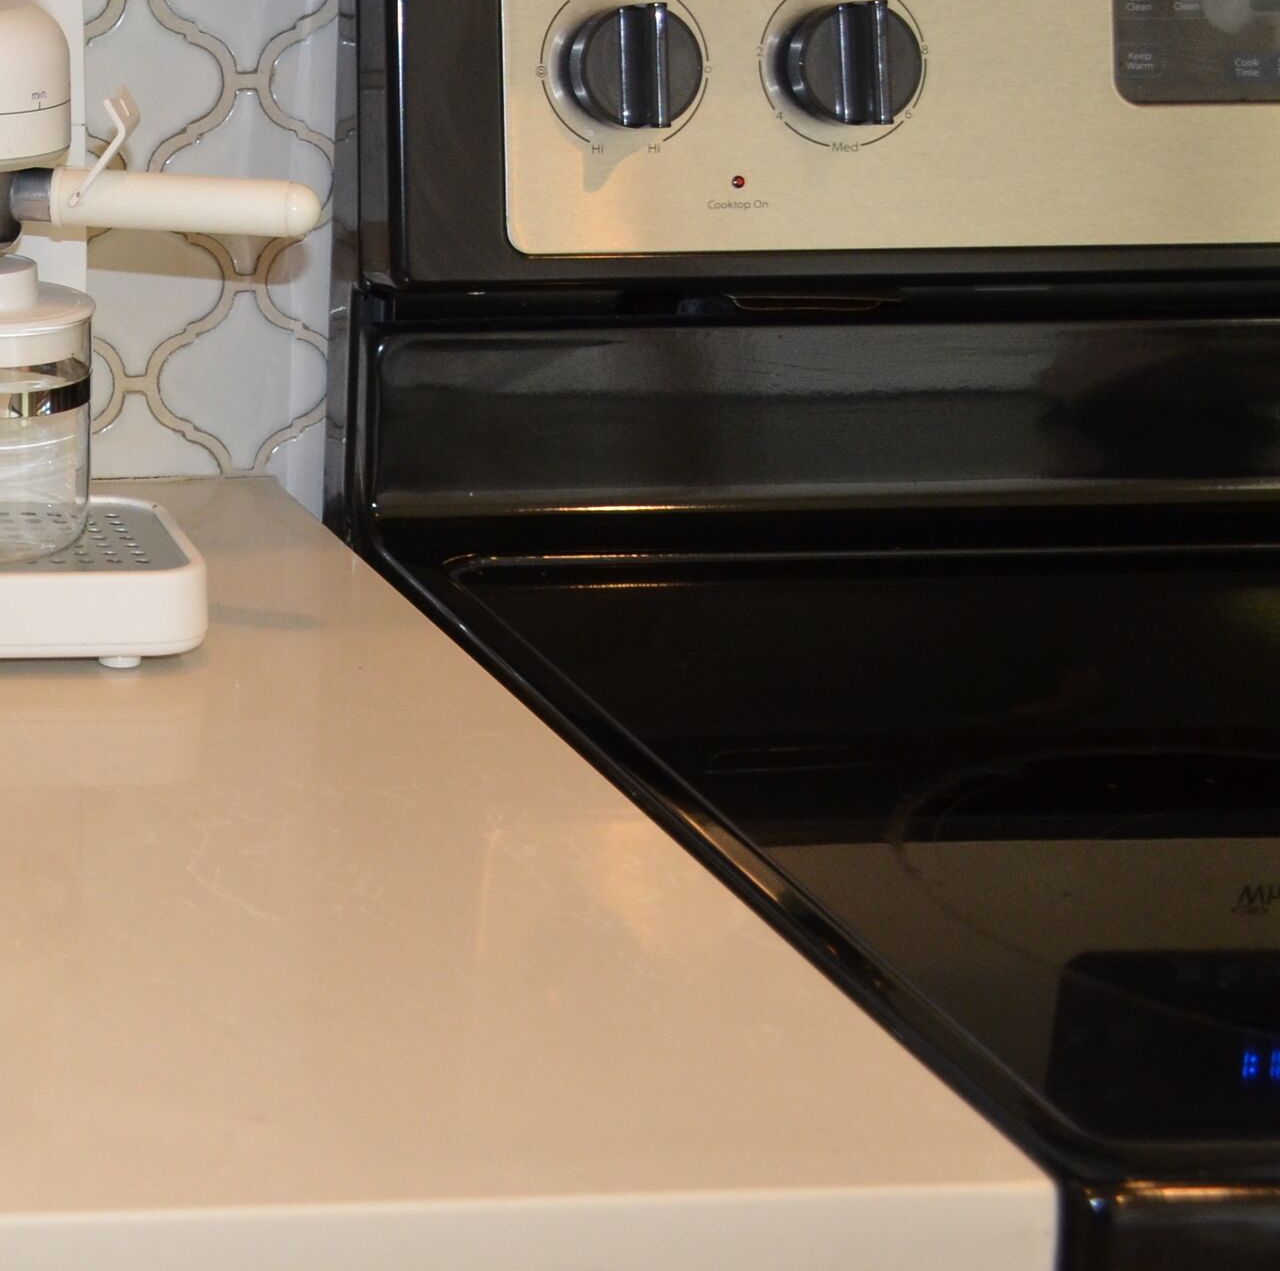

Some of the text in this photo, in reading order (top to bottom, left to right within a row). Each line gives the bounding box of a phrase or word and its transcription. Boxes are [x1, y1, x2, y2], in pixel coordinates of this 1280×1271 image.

[1125, 2, 1152, 11] Clean
[1172, 2, 1200, 11] Clean
[756, 46, 764, 57] 2
[921, 44, 929, 55] 8
[1128, 52, 1152, 63] Keep
[1234, 58, 1259, 68] Cook
[1127, 62, 1154, 71] Warm
[1236, 68, 1259, 77] Time
[31, 90, 47, 101] min
[775, 110, 783, 121] 4
[905, 109, 913, 120] 6
[591, 144, 604, 155] Hi
[647, 143, 661, 154] Hi
[831, 140, 859, 153] Med
[707, 199, 768, 210] Cooktop On
